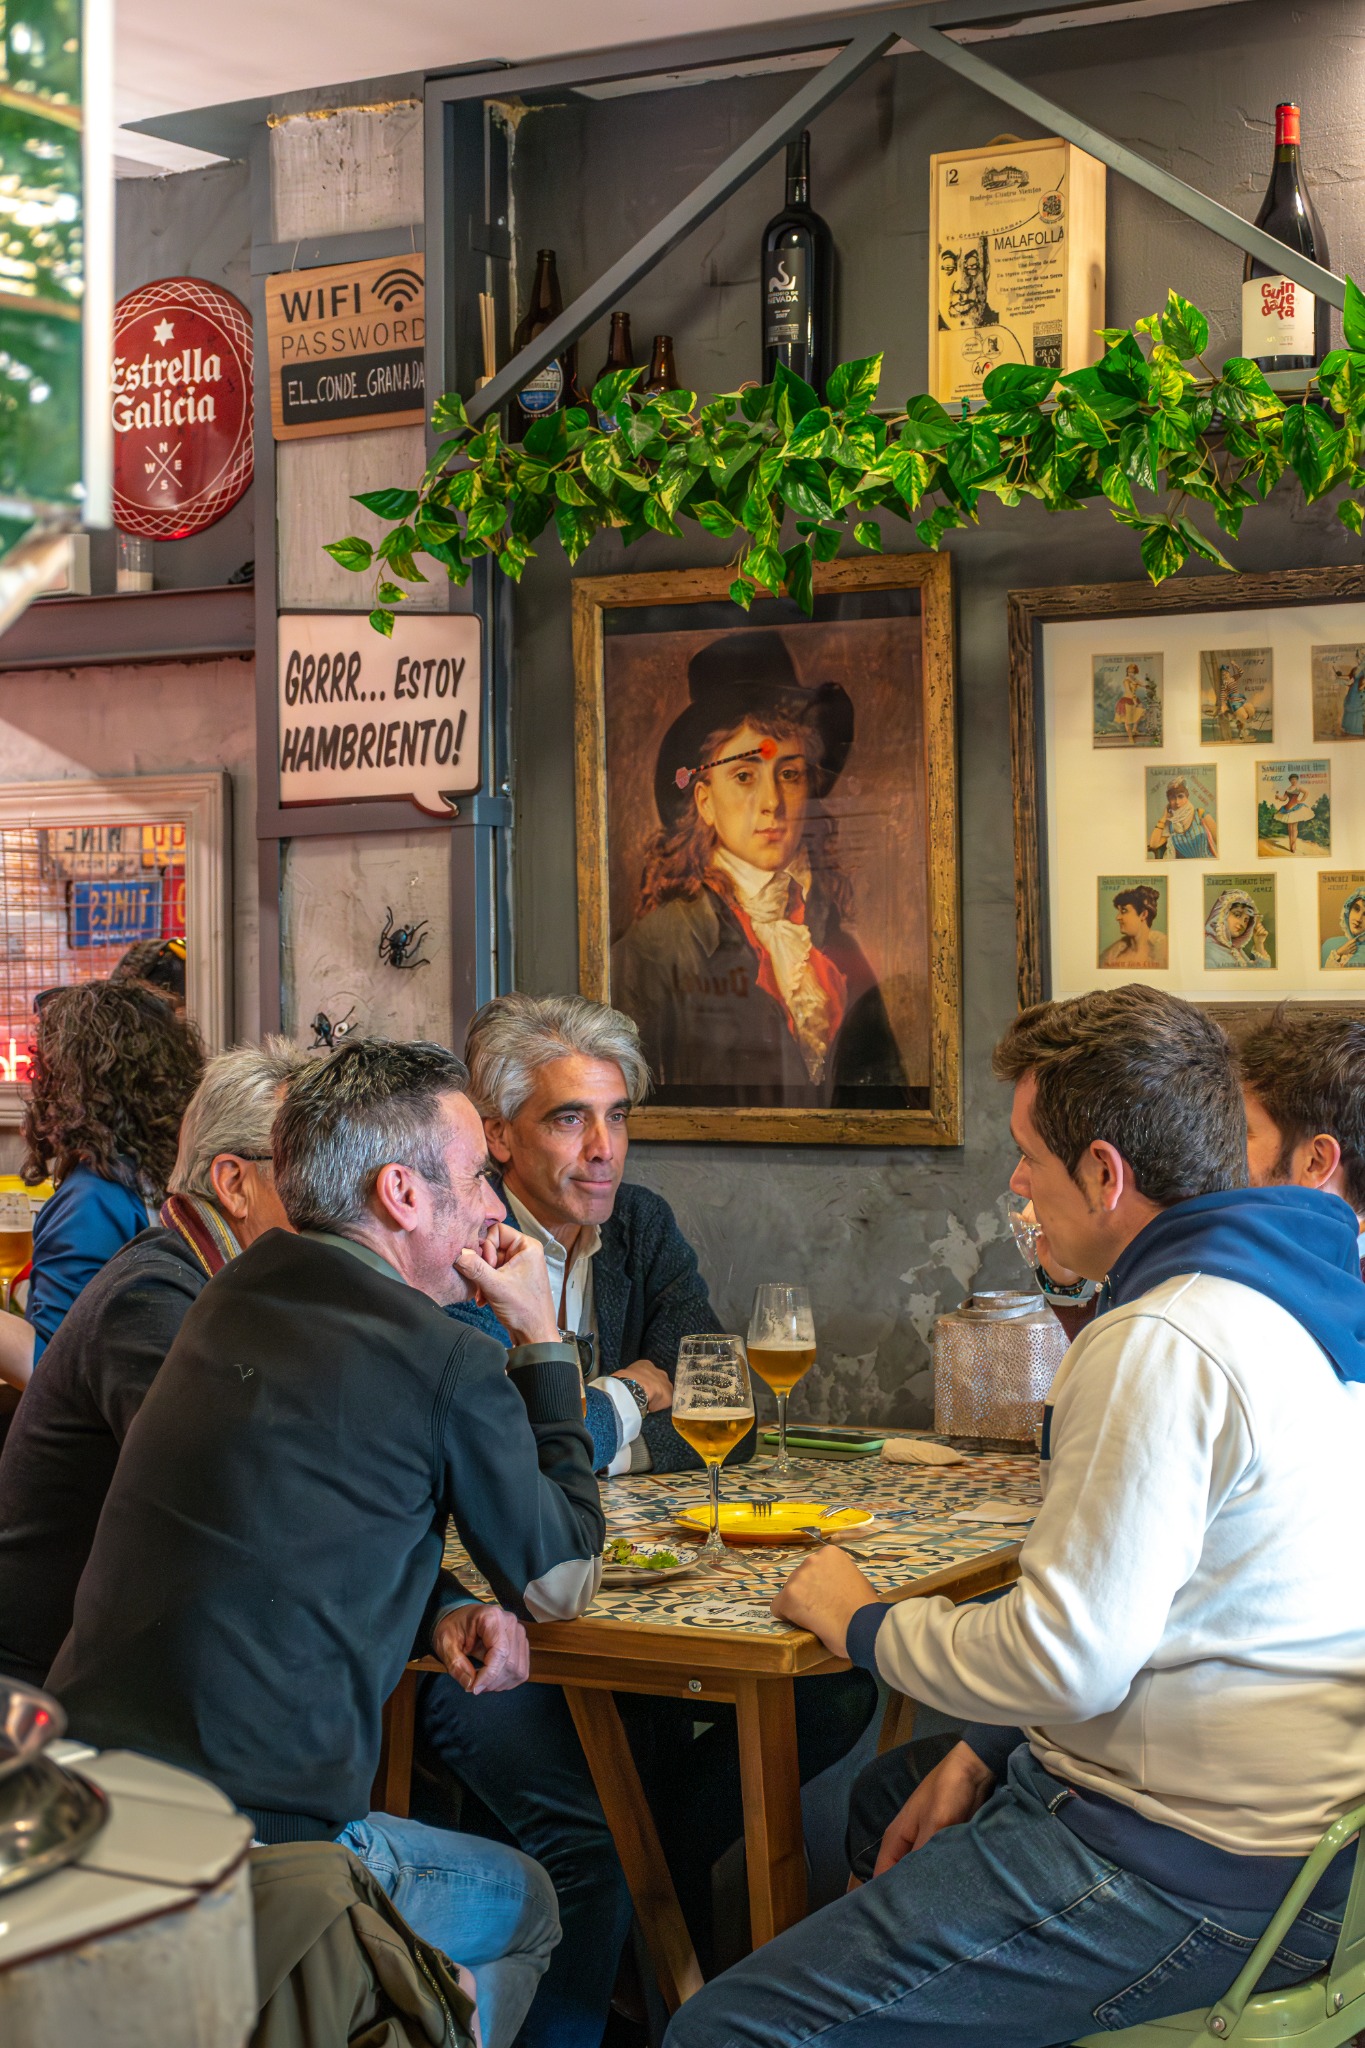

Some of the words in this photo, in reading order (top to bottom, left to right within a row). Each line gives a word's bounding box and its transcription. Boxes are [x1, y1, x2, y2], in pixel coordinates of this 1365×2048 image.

[949, 168, 959, 184] 2
[280, 282, 361, 324] WIFI
[281, 317, 424, 360] PASSWORD
[111, 347, 222, 394] Estrella
[112, 386, 217, 433] Galicia
[144, 462, 156, 474] W
[174, 459, 182, 471] E
[159, 441, 168, 453] N
[160, 479, 169, 491] S
[285, 649, 386, 706] GRRRR...
[394, 656, 466, 700] ESTOY
[281, 709, 468, 773] HAMBRIENTO!
